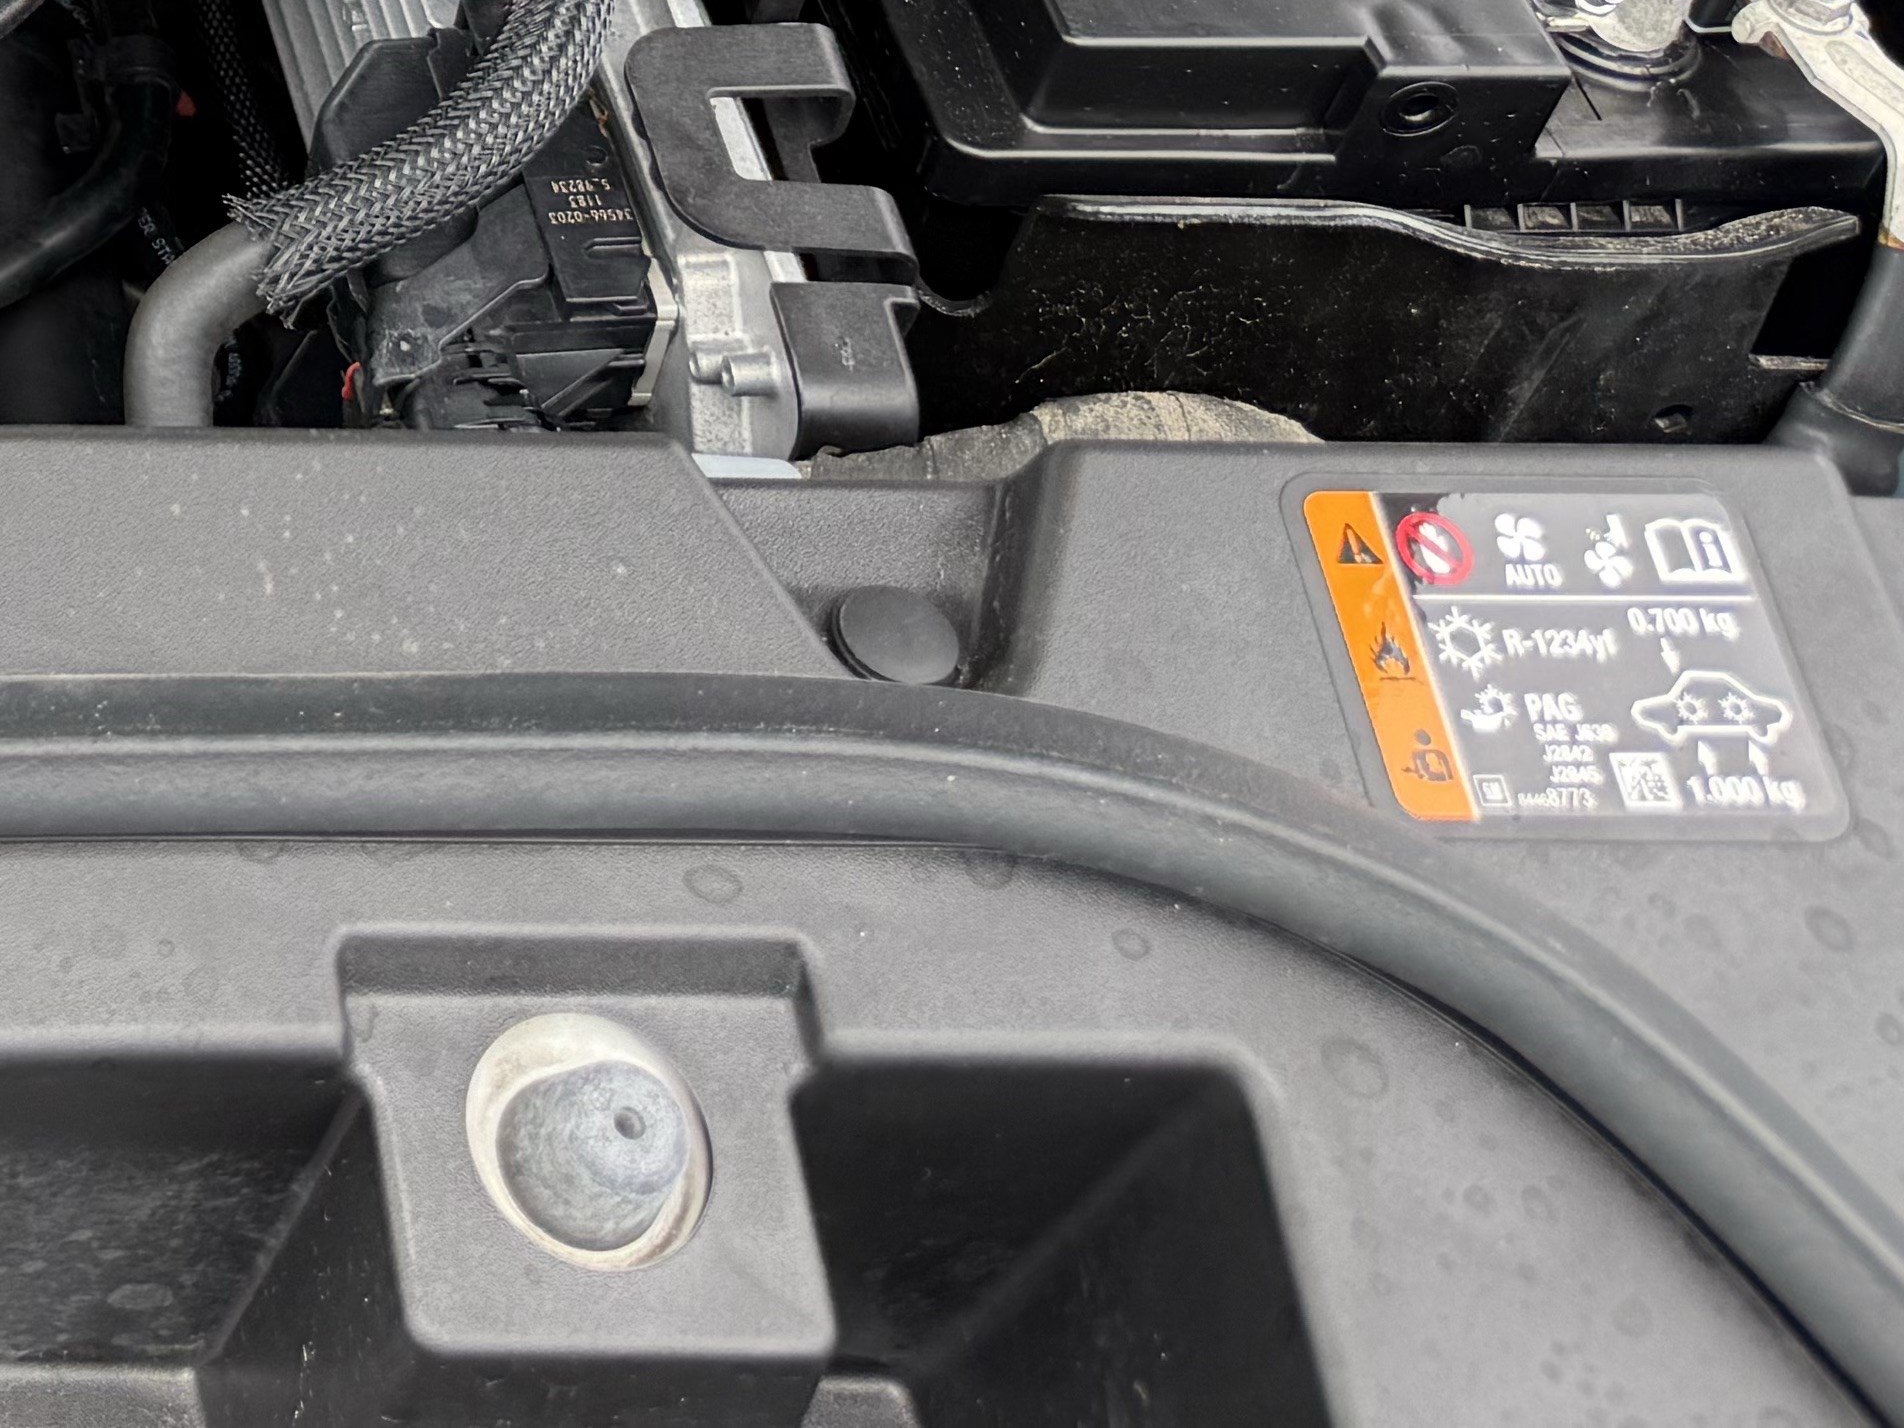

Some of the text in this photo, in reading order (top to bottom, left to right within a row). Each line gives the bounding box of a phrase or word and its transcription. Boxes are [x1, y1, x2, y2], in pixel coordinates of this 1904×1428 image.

[1505, 564, 1562, 587] AUTO
[1628, 608, 1738, 639] 0.700 kg
[1503, 629, 1618, 661] R-1234yf
[1524, 693, 1583, 721] PAG
[1533, 723, 1571, 742] SAE
[1687, 775, 1806, 812] 1.000 kg
